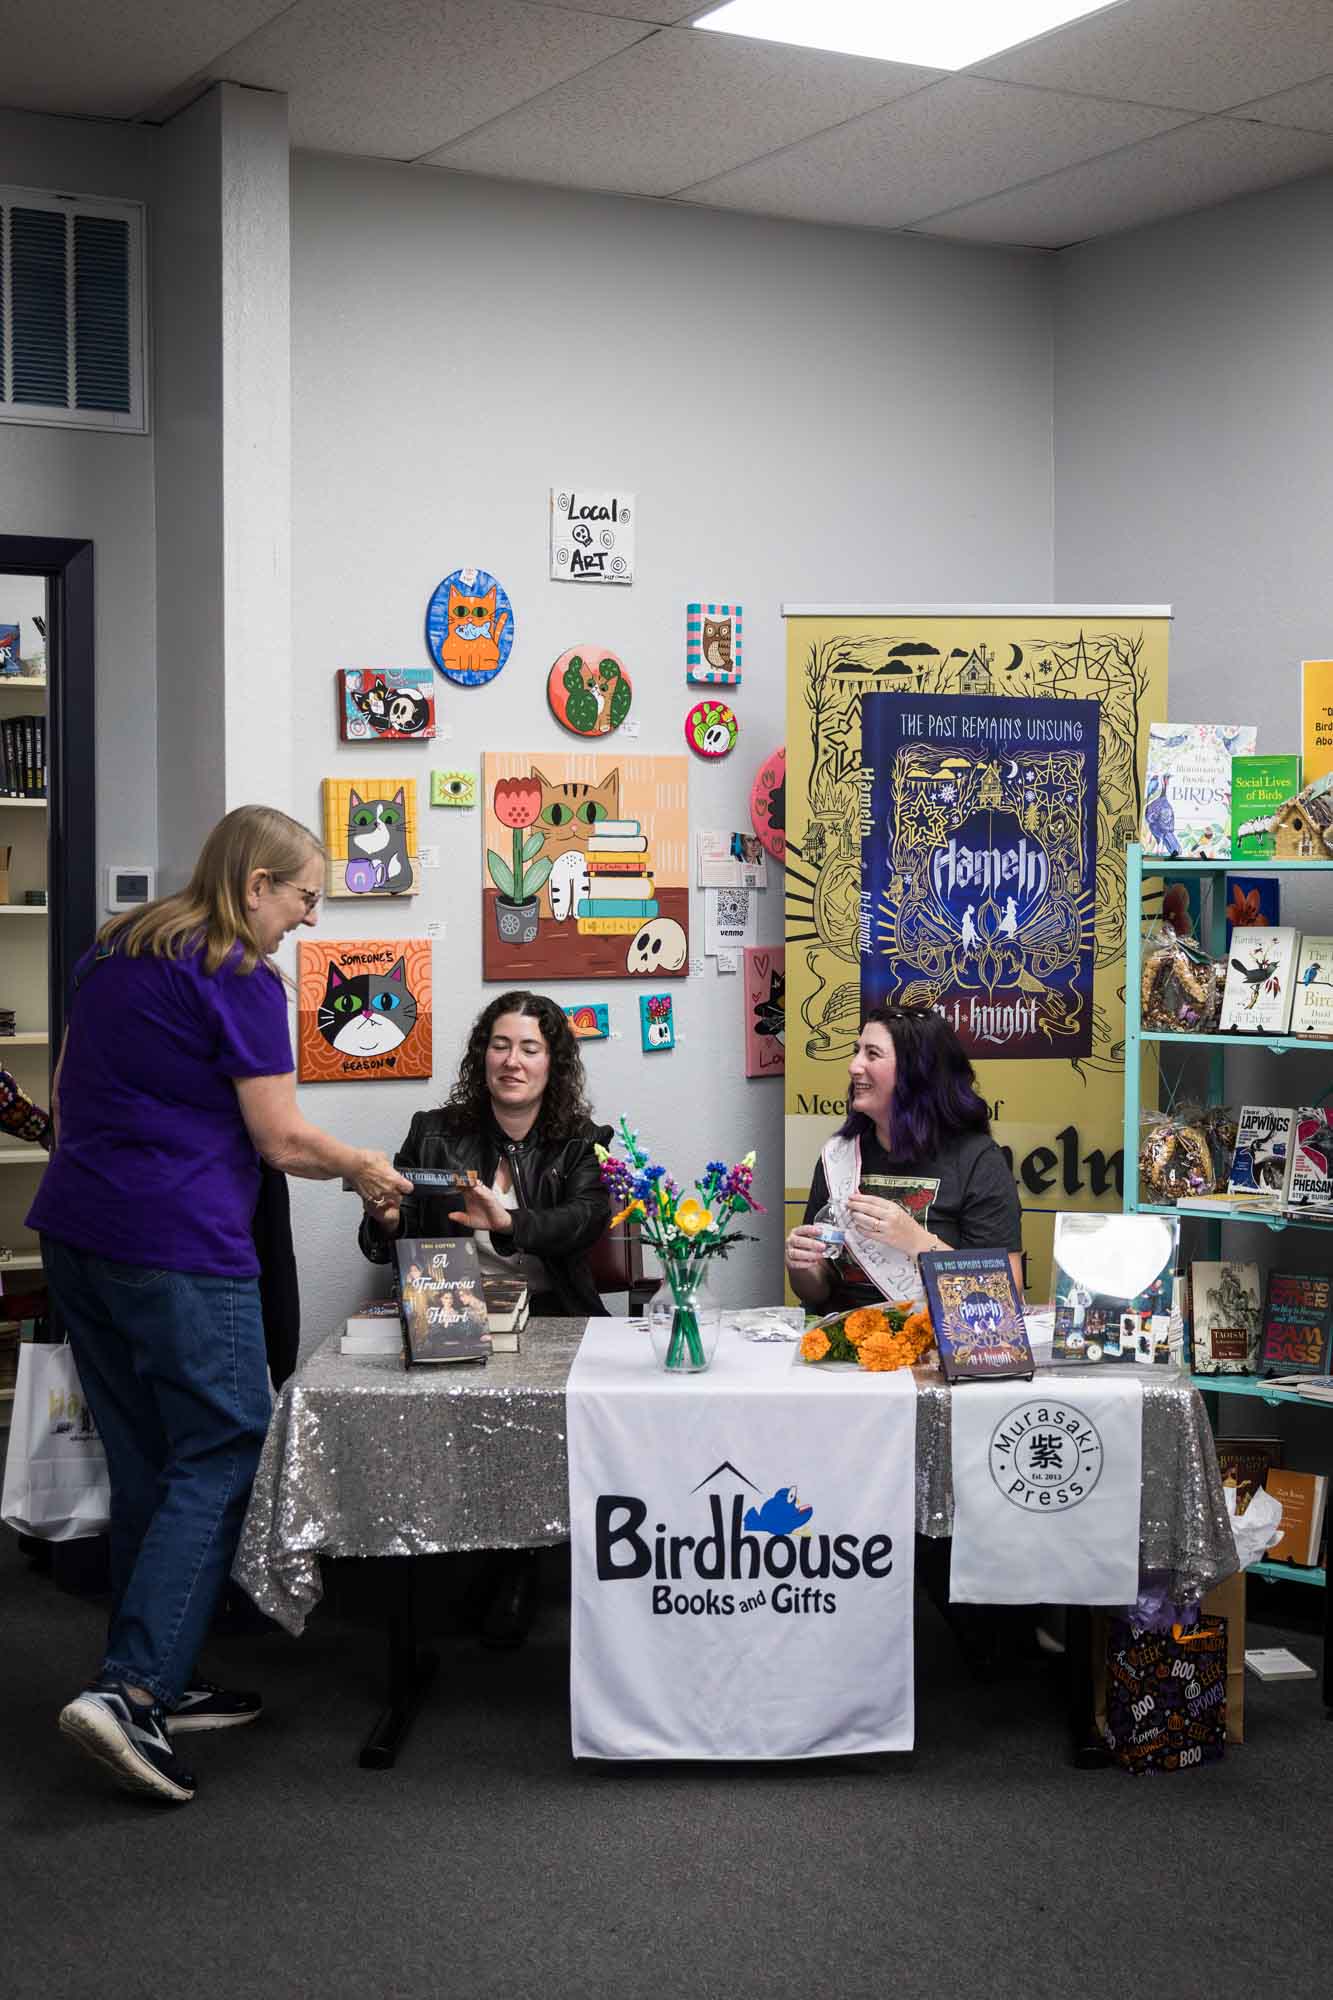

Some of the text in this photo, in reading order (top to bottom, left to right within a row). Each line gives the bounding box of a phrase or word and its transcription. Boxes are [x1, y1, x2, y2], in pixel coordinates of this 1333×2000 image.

[568, 493, 617, 522] Local
[570, 549, 608, 572] ART
[900, 714, 1083, 742] THE PAST REMAINS UNSUNG
[1236, 776, 1291, 788] Social Lives
[1172, 786, 1224, 805] BIRDS
[1246, 789, 1283, 800] of Birds
[933, 838, 1049, 902] Hameln
[720, 929, 744, 937] venmo
[342, 1059, 384, 1073] REASON
[1241, 1115, 1290, 1132] LAPWINGS
[412, 1276, 476, 1294] Traitorous
[427, 1306, 469, 1329] Heart
[960, 1299, 1003, 1318] Hameln
[1267, 1322, 1323, 1345] RAM
[1264, 1343, 1322, 1365] DASS
[994, 1408, 1100, 1455] Murasaki
[1008, 1479, 1084, 1506] Press
[595, 1494, 893, 1581] Birdhouse
[652, 1583, 837, 1615] Books and Gifts
[1171, 1659, 1195, 1680] BOO
[1131, 1694, 1155, 1722] BOO
[1180, 1745, 1201, 1767] BOO
